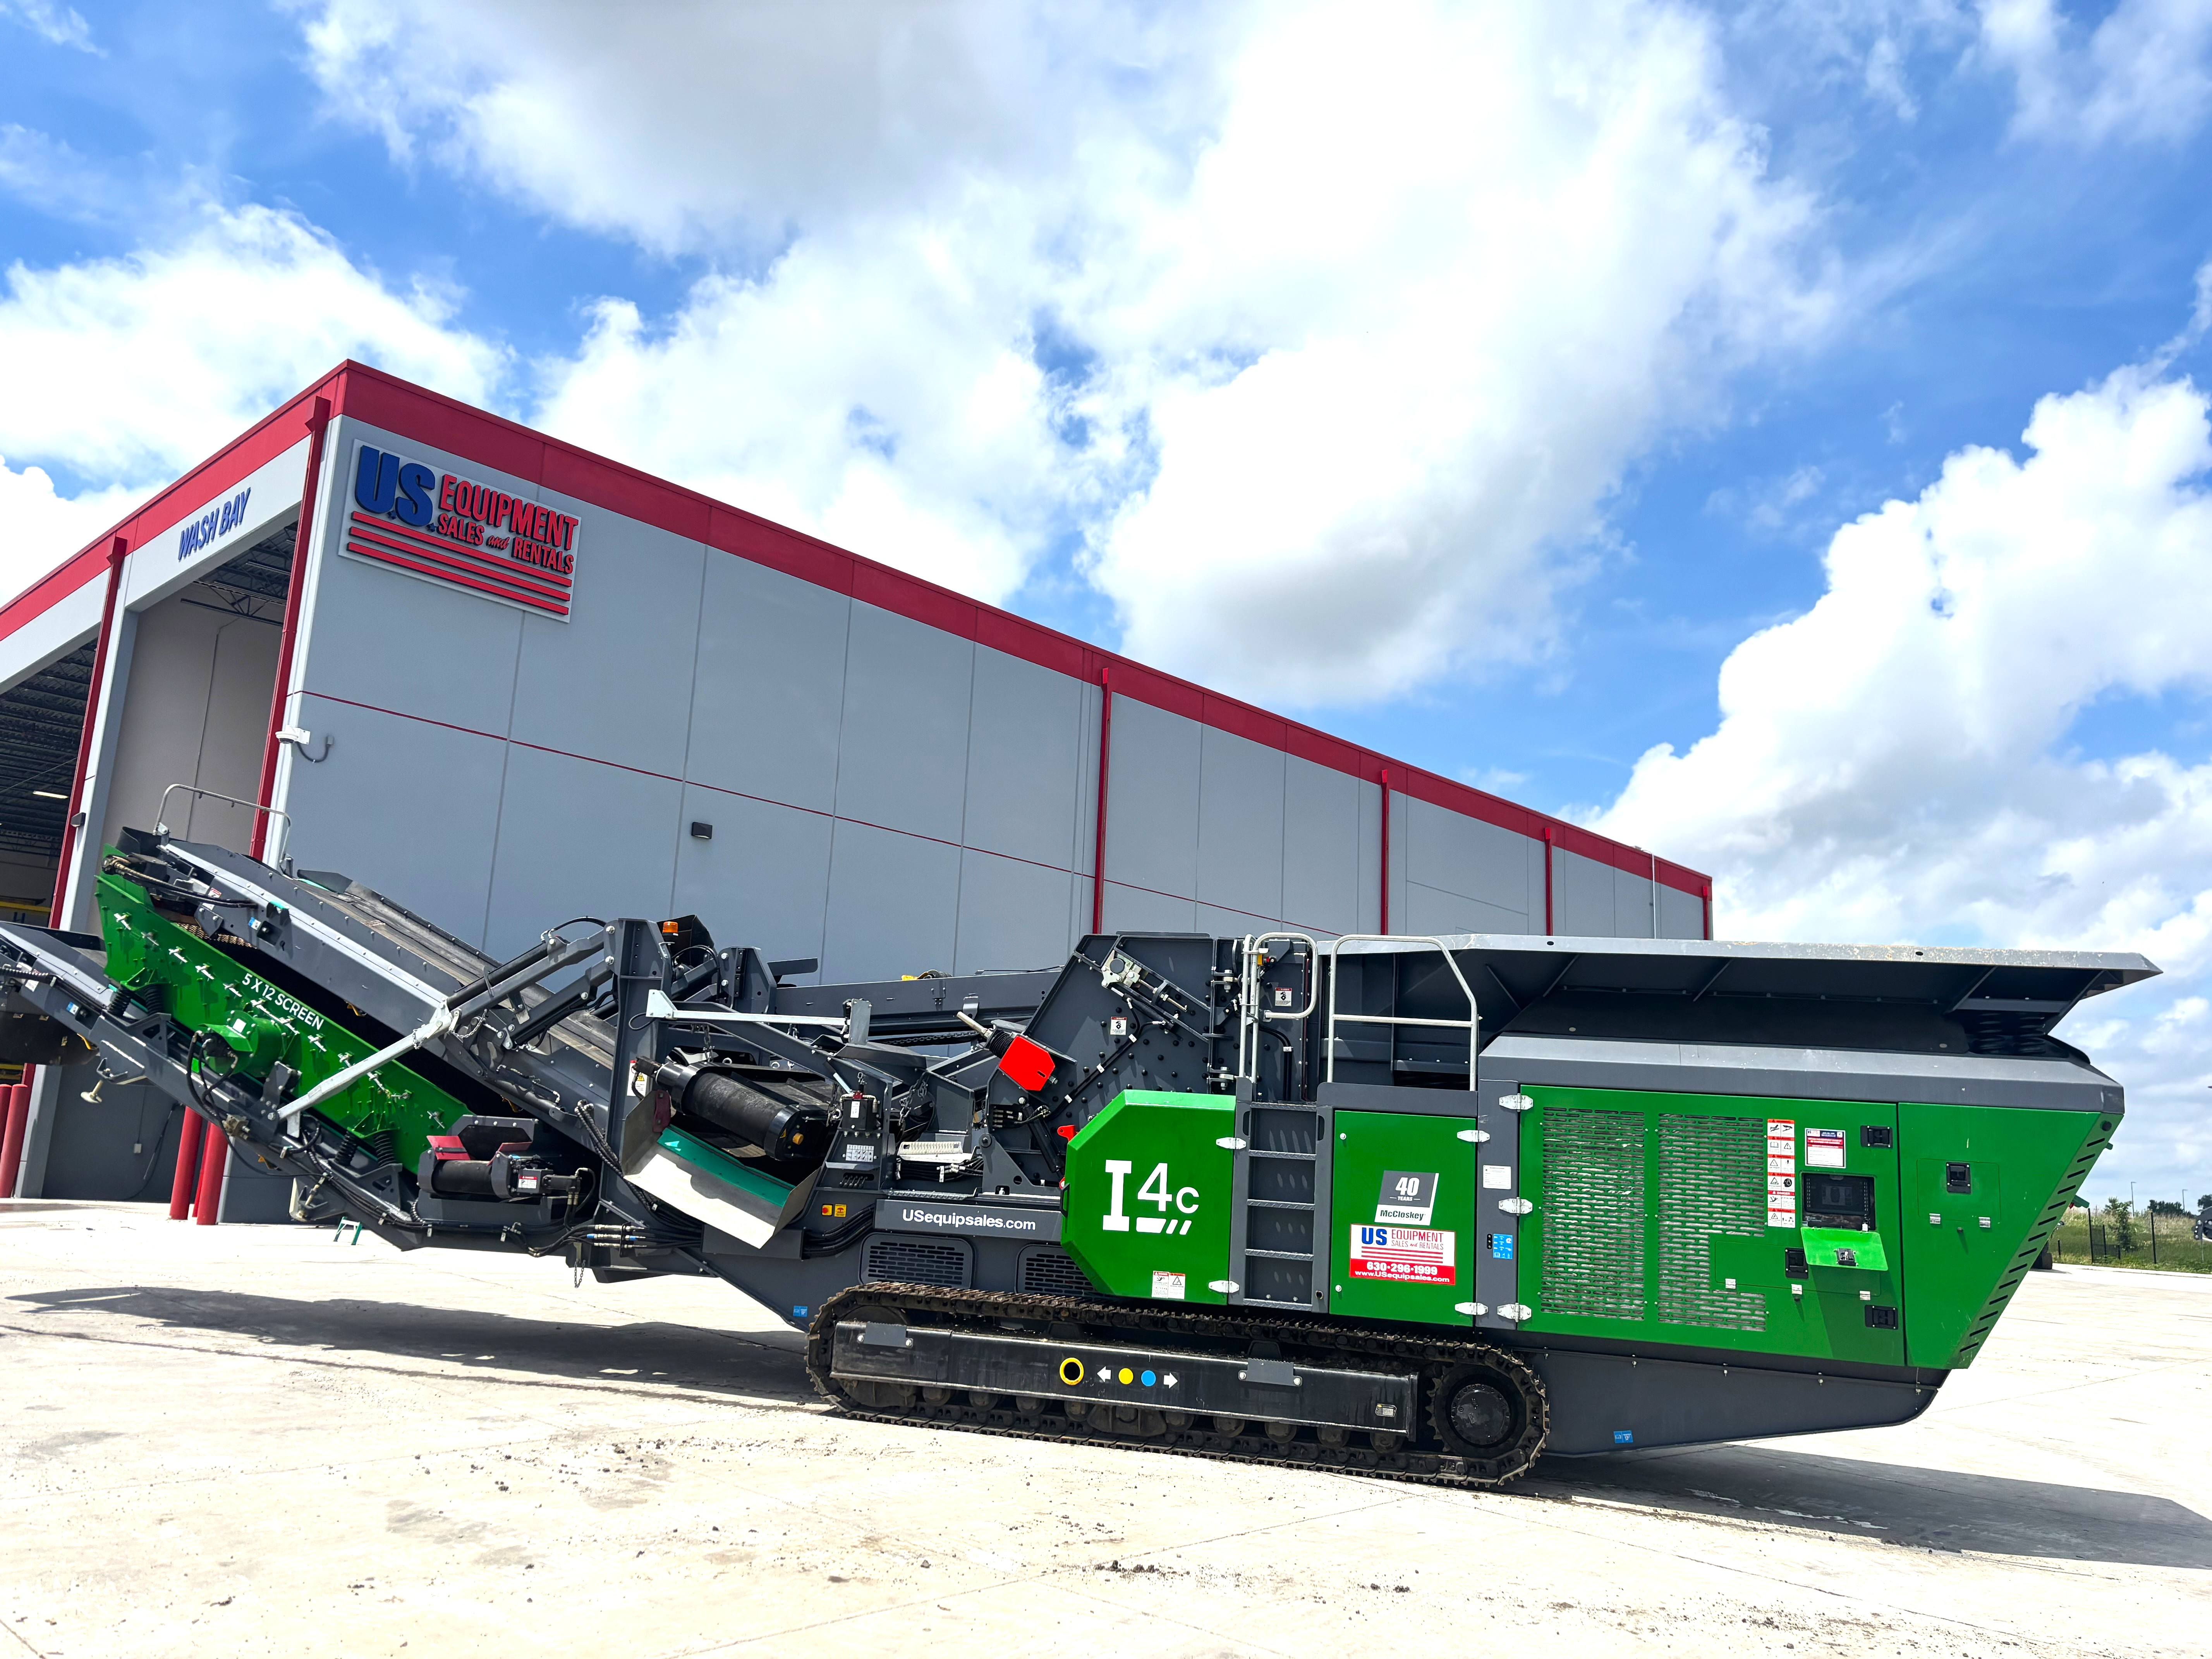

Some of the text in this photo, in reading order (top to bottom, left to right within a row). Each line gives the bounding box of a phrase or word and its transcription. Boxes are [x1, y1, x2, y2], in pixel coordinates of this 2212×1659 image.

[438, 474, 579, 550] EQUIPMENT
[178, 487, 251, 562] WASH BAY
[436, 513, 574, 574] SALES and RENTALS
[242, 973, 324, 1030] 5 X 12 SCREEN
[1395, 1177, 1420, 1196] 40
[903, 1209, 1036, 1230] USequipsales.com
[1380, 1210, 1424, 1221] McCloskey
[1391, 1229, 1444, 1242] EQUIPMENT
[1419, 1242, 1443, 1250] RENTALS
[1355, 1271, 1449, 1282] www.USequipsales.com
